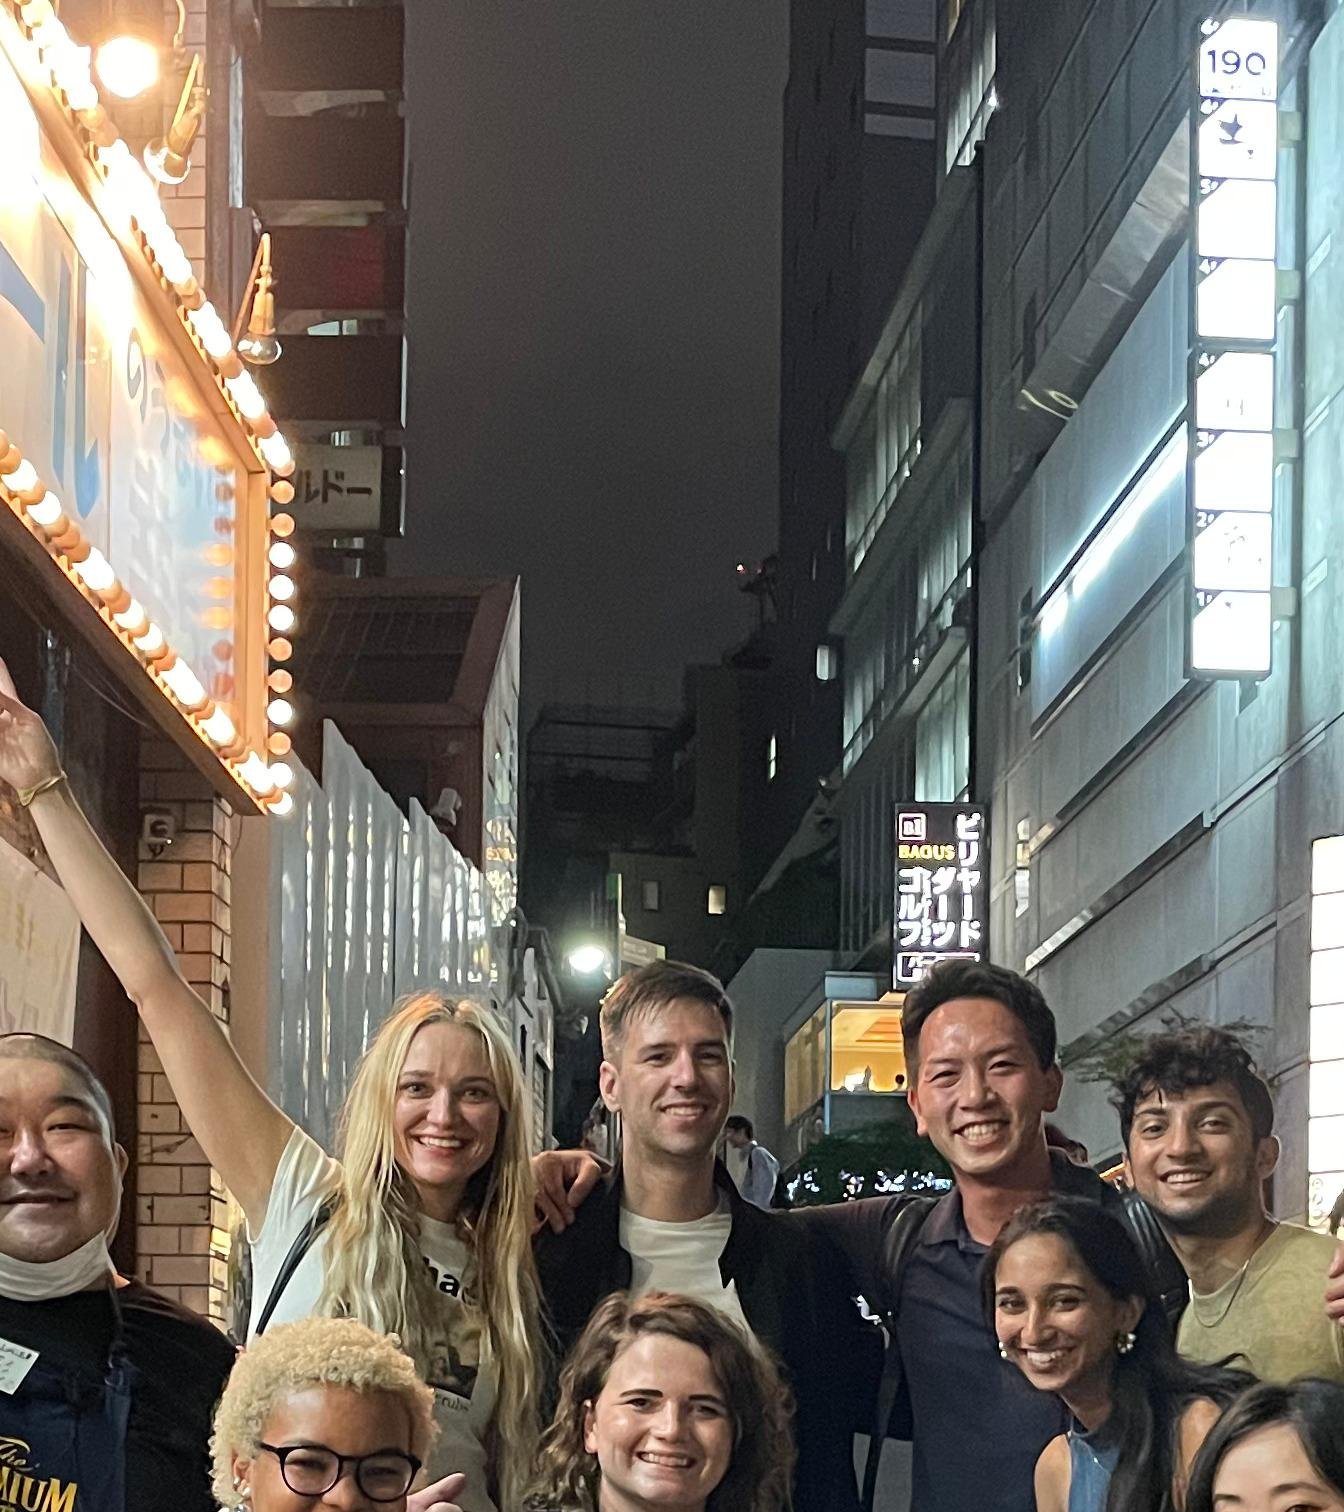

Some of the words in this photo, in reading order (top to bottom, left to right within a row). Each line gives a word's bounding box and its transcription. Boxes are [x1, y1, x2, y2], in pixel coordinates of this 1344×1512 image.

[956, 812, 981, 948] ビリヤード
